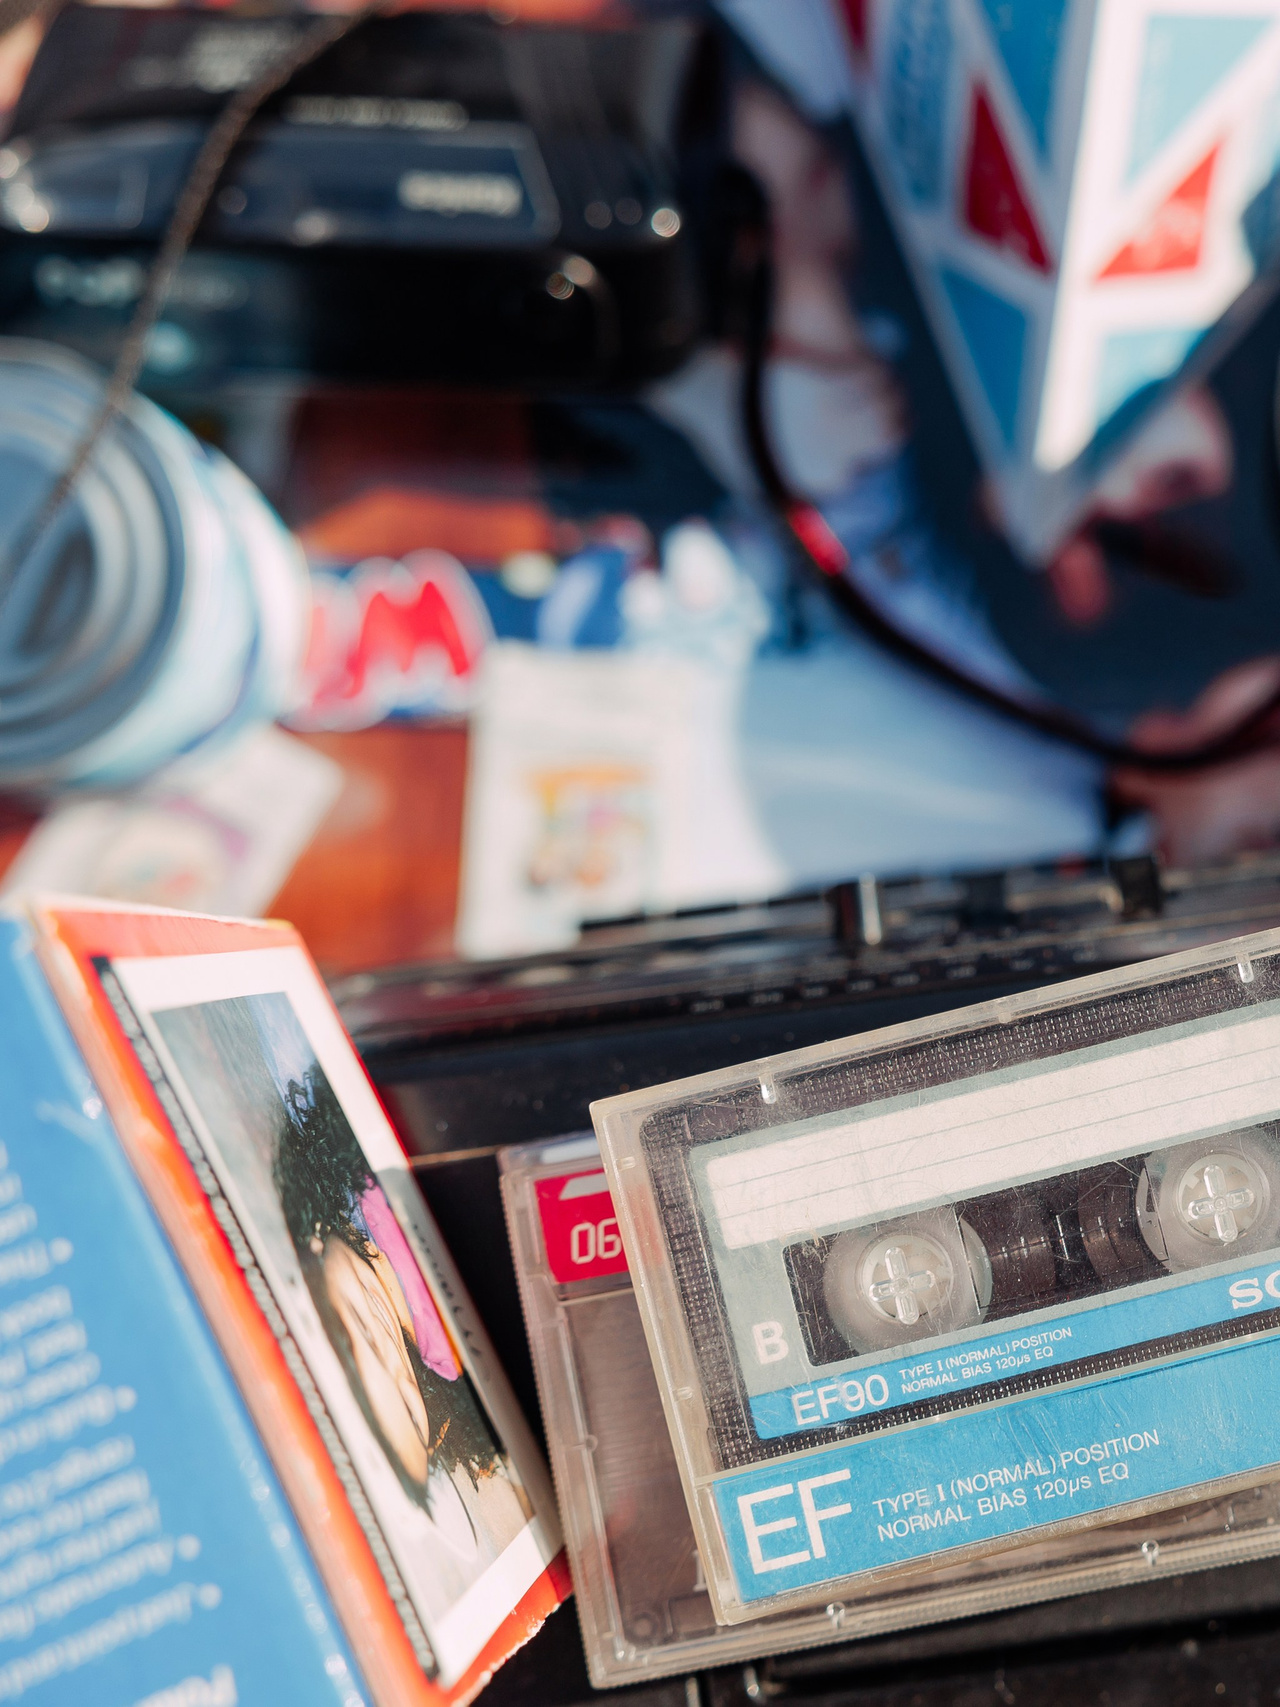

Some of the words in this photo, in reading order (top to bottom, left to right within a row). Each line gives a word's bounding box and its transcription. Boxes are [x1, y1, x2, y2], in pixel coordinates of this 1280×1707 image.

[753, 1320, 789, 1365] B
[899, 1362, 934, 1381] TYPE
[1012, 1326, 1073, 1351] POSITION
[901, 1371, 958, 1395] NORMAL
[962, 1362, 992, 1380] BIAS
[1034, 1345, 1054, 1361] EQ
[791, 1374, 889, 1425] EF90
[872, 1487, 930, 1518] TYPE
[1061, 1428, 1161, 1471] POSITION
[737, 1468, 852, 1575] EF
[877, 1505, 972, 1543] NORMAL
[977, 1488, 1028, 1517] BIAS
[1099, 1461, 1131, 1486] EQ
